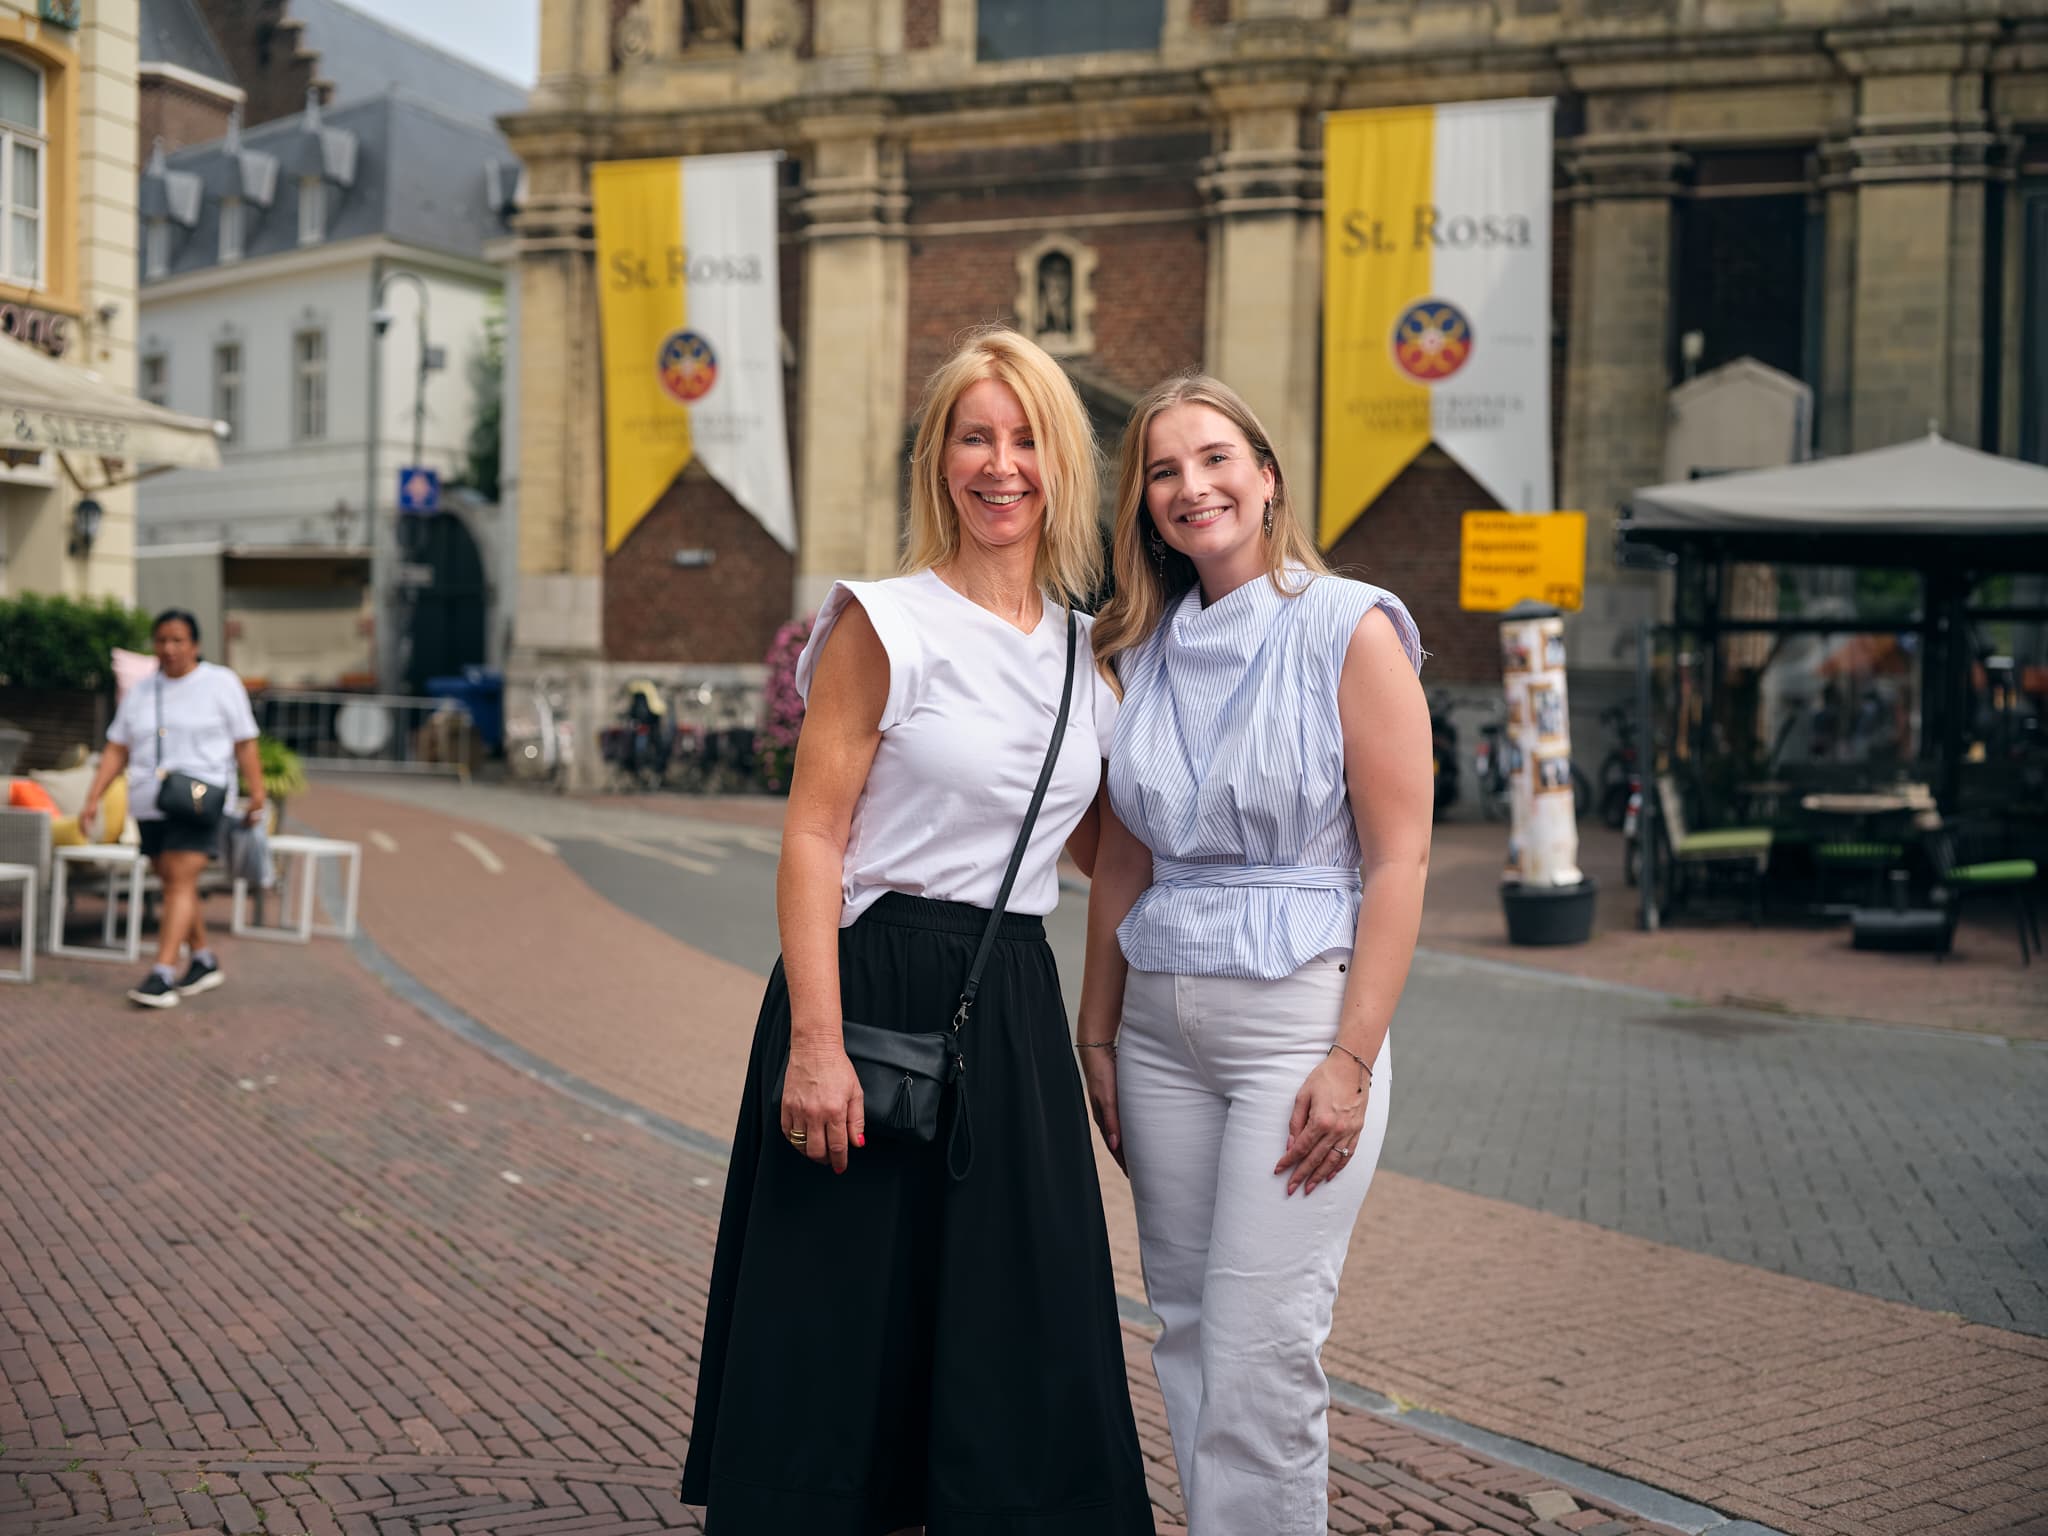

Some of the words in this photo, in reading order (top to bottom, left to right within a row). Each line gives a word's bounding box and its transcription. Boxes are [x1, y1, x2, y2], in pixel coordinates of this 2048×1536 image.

[1340, 209, 1396, 257] St.
[1414, 203, 1530, 250] Rosa
[610, 250, 658, 293] St.
[665, 246, 762, 288] Rosa
